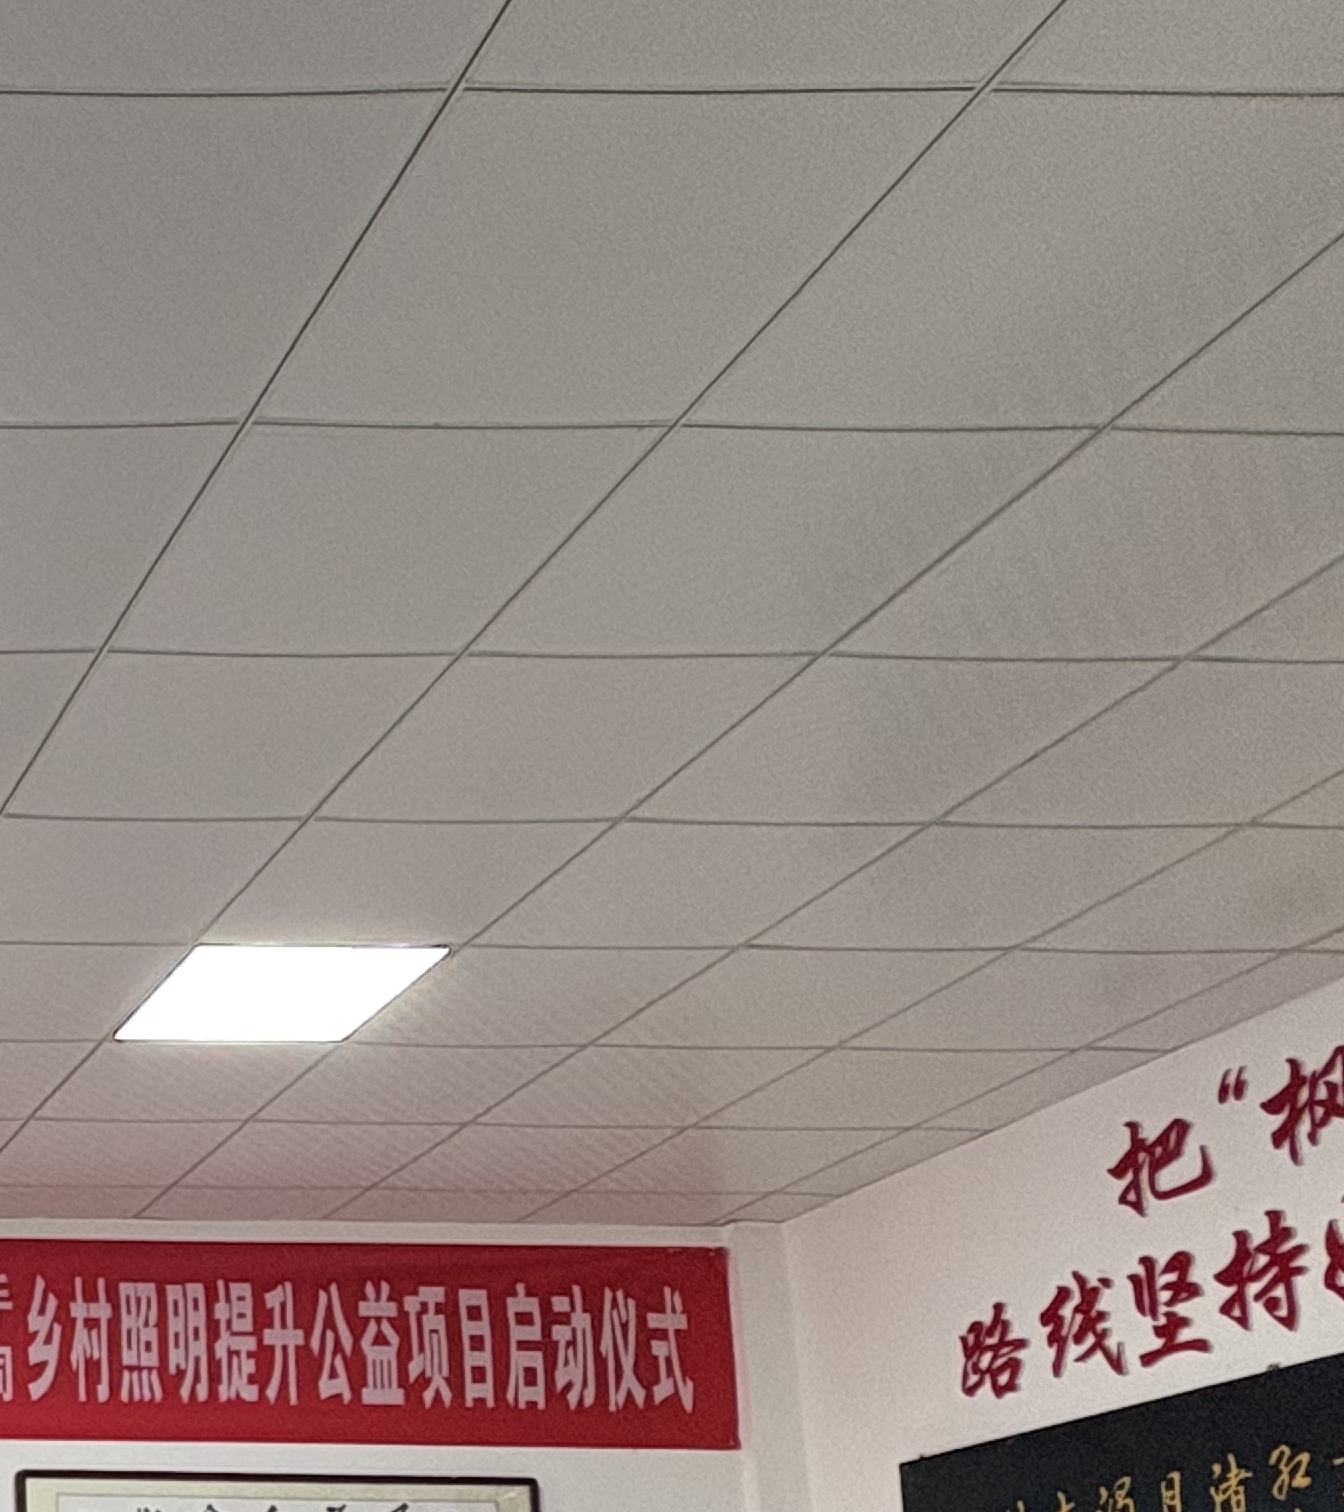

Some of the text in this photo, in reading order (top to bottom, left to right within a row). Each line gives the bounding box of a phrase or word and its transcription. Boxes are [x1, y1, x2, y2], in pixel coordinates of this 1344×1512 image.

[26, 1274, 694, 1414] 乡村照明提升公益项目启动仪式
